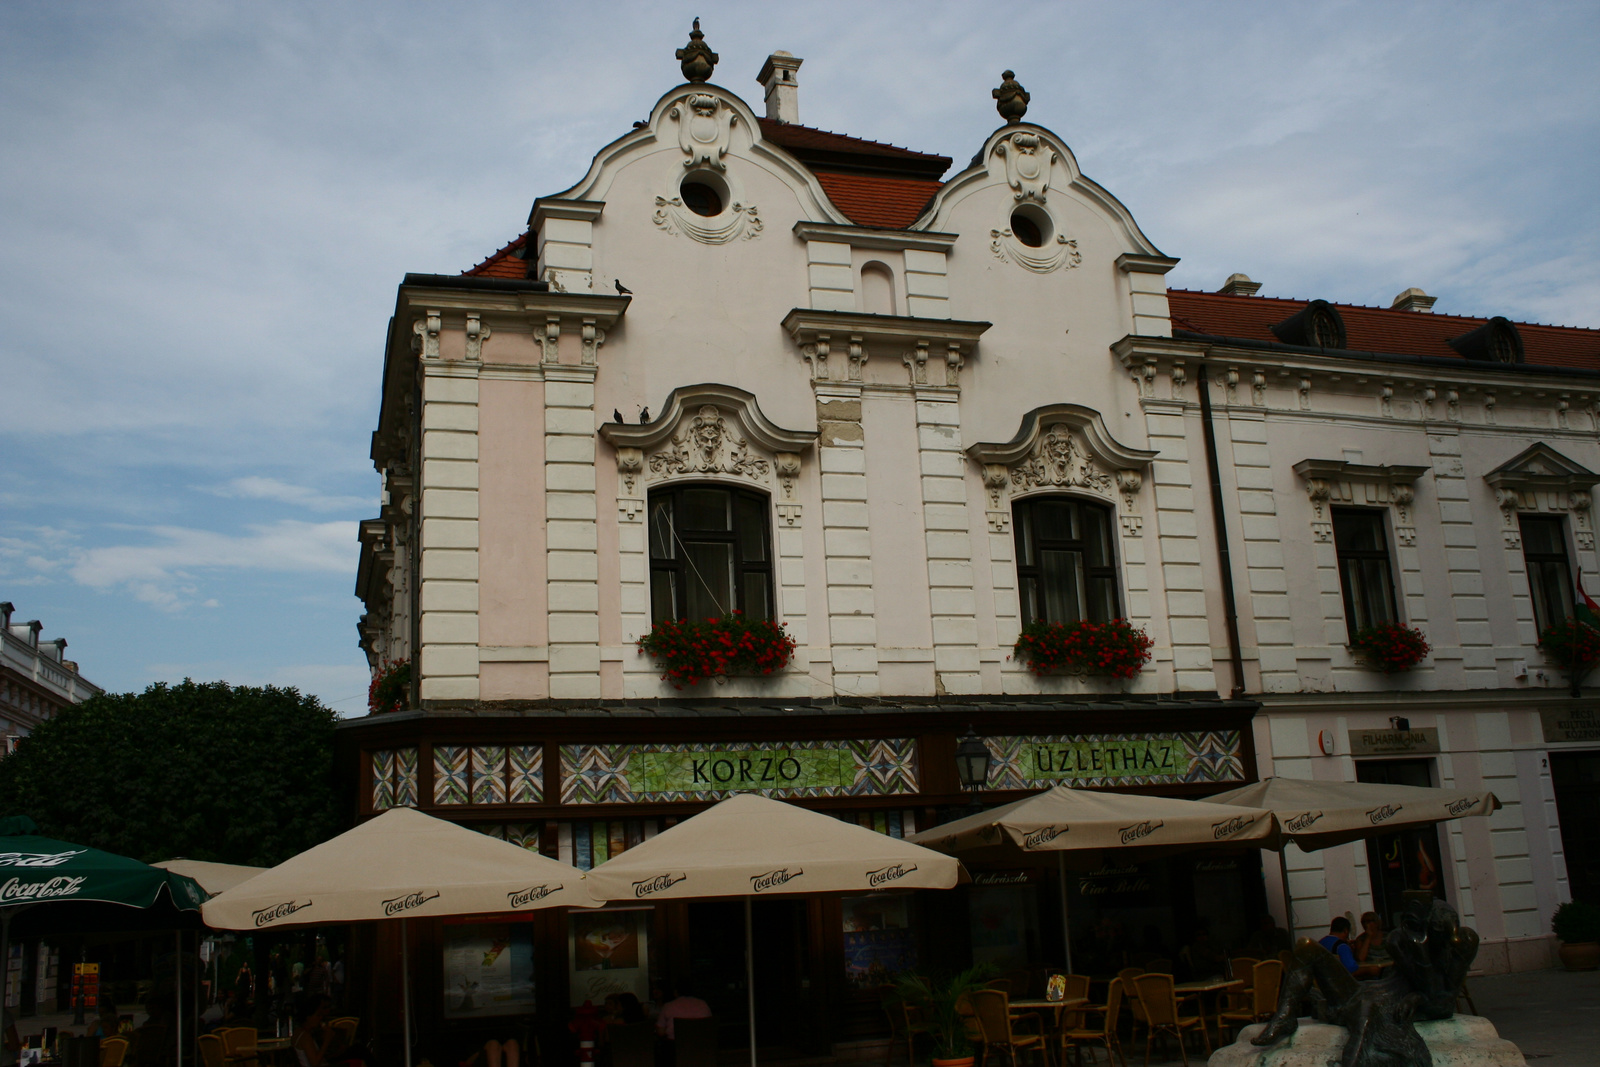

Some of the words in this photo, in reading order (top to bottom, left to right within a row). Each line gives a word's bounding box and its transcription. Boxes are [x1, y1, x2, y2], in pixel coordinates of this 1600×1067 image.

[693, 750, 801, 783] KORZÓ
[1037, 741, 1173, 772] ÜZLETHÁZ
[1542, 759, 1548, 768] 2
[0, 876, 88, 902] Coca-Cola
